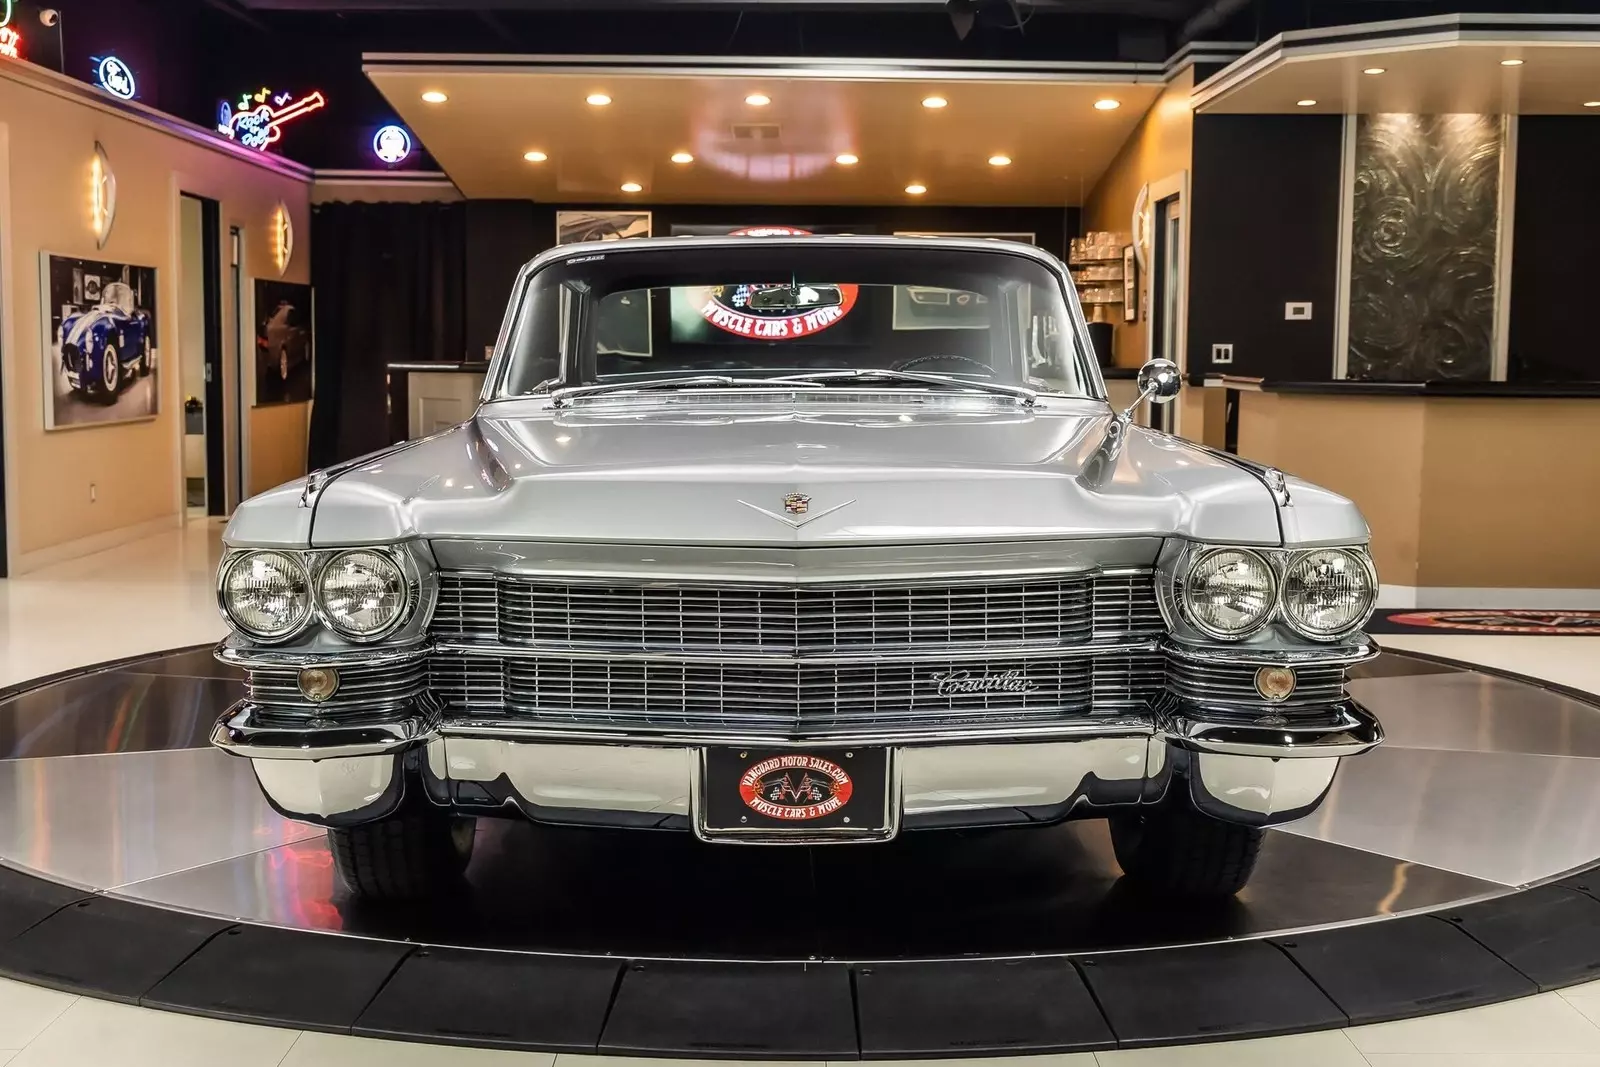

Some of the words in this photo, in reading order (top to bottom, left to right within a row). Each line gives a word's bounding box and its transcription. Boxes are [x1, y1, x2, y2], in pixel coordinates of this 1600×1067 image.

[701, 300, 753, 334] MUSCLE
[754, 319, 789, 337] CARS
[792, 317, 803, 334] &
[804, 306, 844, 332] MORE
[930, 669, 1040, 697] Cadillac
[742, 758, 780, 787] VANGUARD
[781, 756, 808, 767] MOTOR
[809, 757, 849, 785] SALES.COM
[749, 797, 784, 817] MUSCLE
[784, 807, 806, 818] CARS
[809, 807, 816, 816] &
[818, 796, 843, 815] MORE
